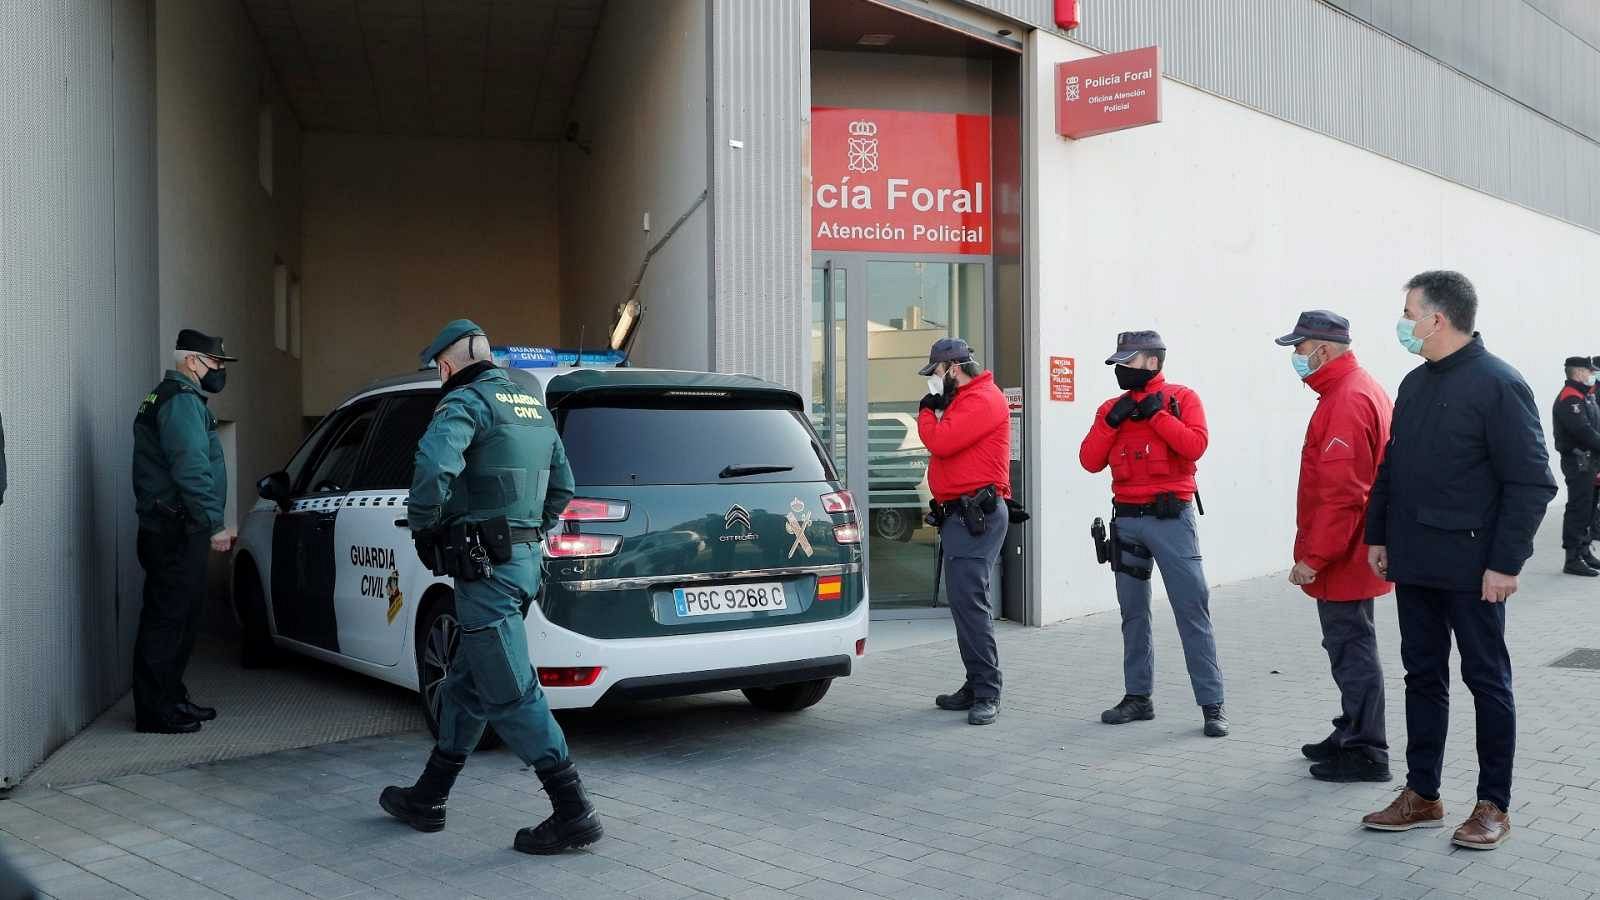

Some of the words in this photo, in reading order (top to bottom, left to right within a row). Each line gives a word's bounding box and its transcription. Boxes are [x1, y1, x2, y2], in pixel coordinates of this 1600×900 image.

[1085, 75, 1120, 88] Policía
[1124, 68, 1152, 82] Foral
[1104, 103, 1130, 113] Policial
[887, 178, 983, 213] Foral
[817, 221, 905, 240] Atención
[913, 224, 983, 243] Policial
[514, 407, 542, 419] CIVIL
[351, 545, 396, 570] GUARDIA
[361, 574, 384, 599] CIVIL
[686, 590, 721, 612] PGC
[724, 588, 768, 609] 9268
[771, 587, 783, 606] C
